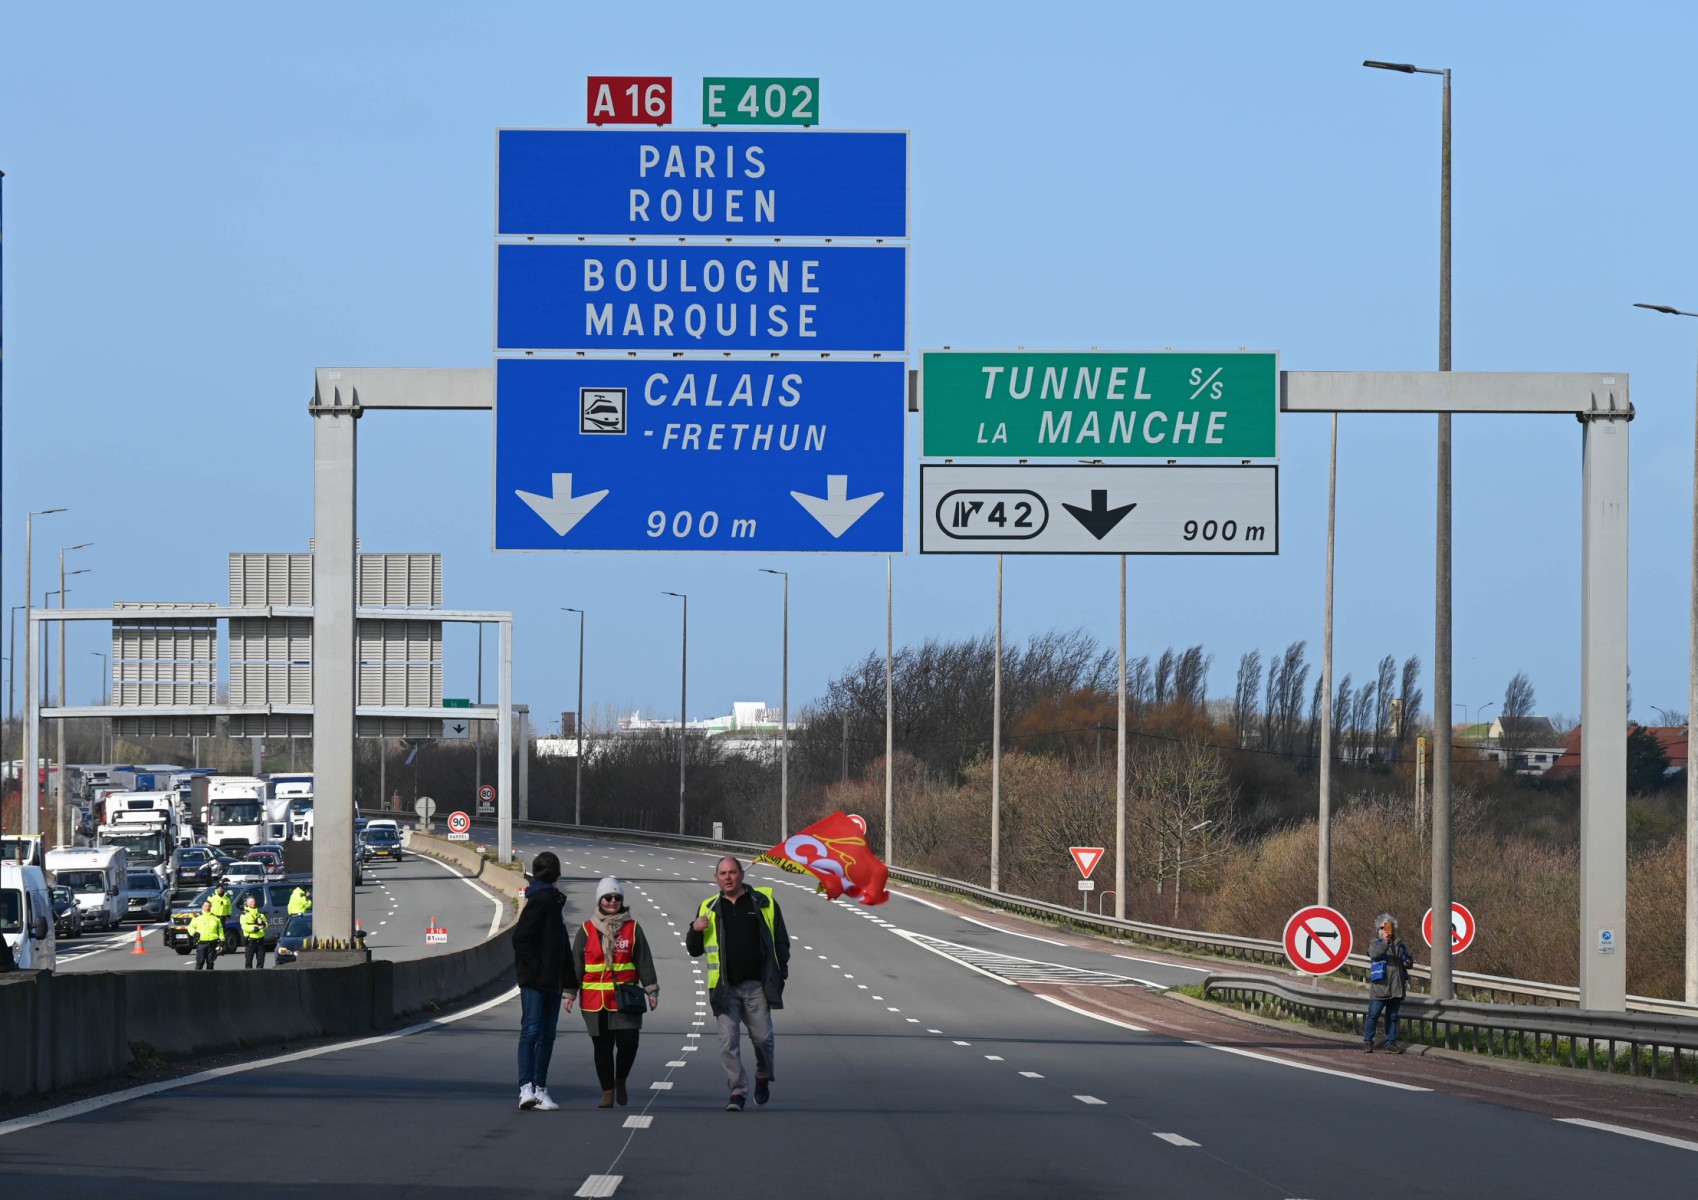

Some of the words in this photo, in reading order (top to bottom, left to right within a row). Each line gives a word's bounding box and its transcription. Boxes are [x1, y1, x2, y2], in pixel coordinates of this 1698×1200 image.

[594, 84, 615, 117] A
[625, 84, 666, 117] 16
[709, 84, 726, 117] E
[738, 85, 813, 118] 402
[639, 145, 766, 178] PARIS
[629, 188, 775, 222] ROUEN
[584, 259, 820, 293] BOULOGNE
[585, 303, 818, 339] MARQUISE
[644, 373, 803, 407] CALAIS
[981, 366, 1152, 400] TUNNEL
[977, 422, 1008, 443] LA
[1038, 411, 1228, 444] MANCHE
[646, 510, 719, 538] 900
[731, 519, 757, 538] m
[987, 501, 1033, 528] 42
[1183, 519, 1238, 541] 900
[1245, 525, 1265, 541] m
[452, 818, 465, 827] 90
